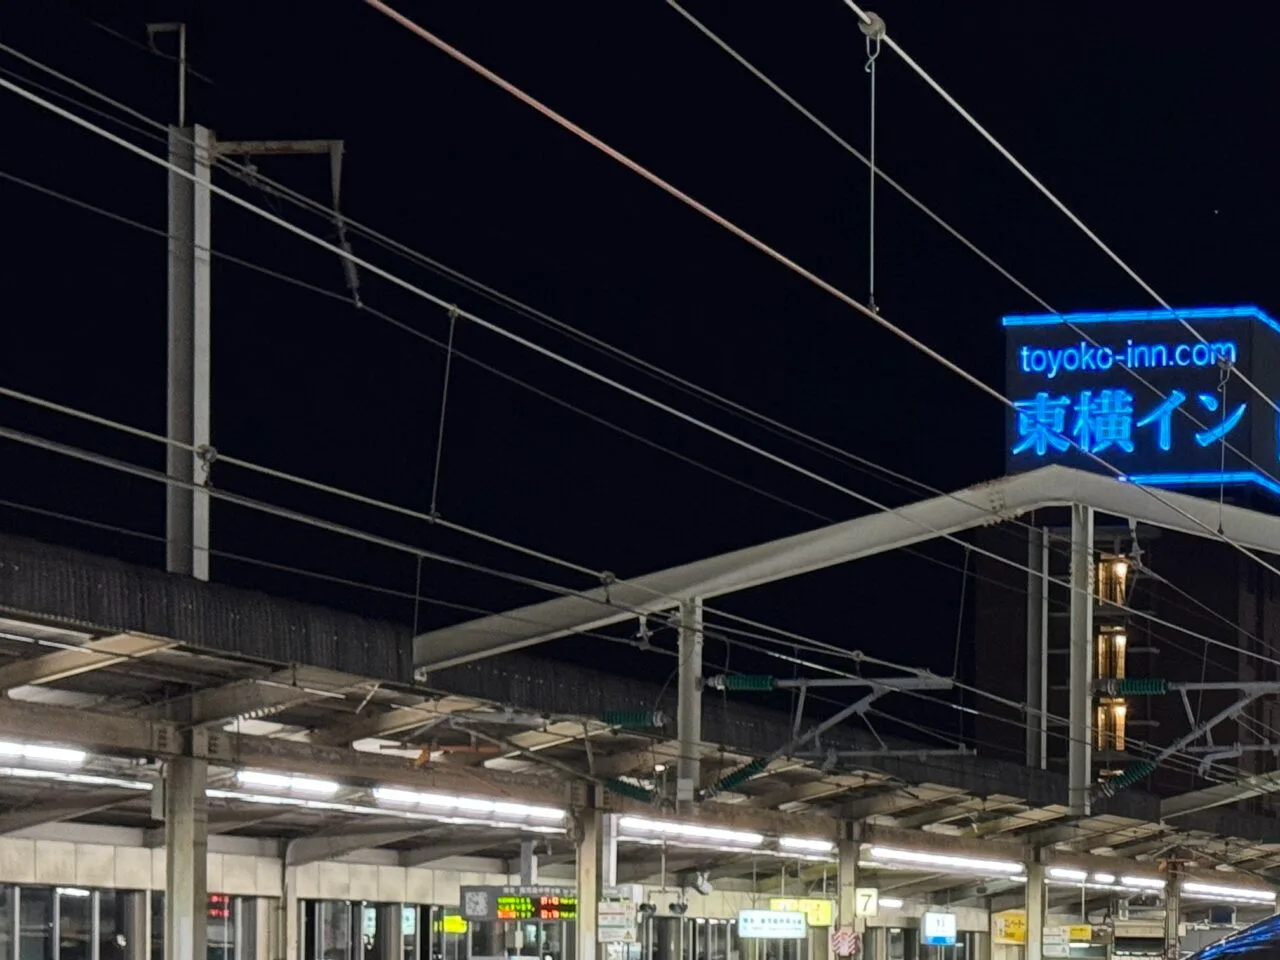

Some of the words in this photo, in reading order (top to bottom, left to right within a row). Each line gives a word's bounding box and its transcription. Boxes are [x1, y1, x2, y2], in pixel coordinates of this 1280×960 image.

[1020, 339, 1237, 378] toyoko-inn.com
[1012, 389, 1247, 456] 東横イン
[860, 894, 873, 912] 7
